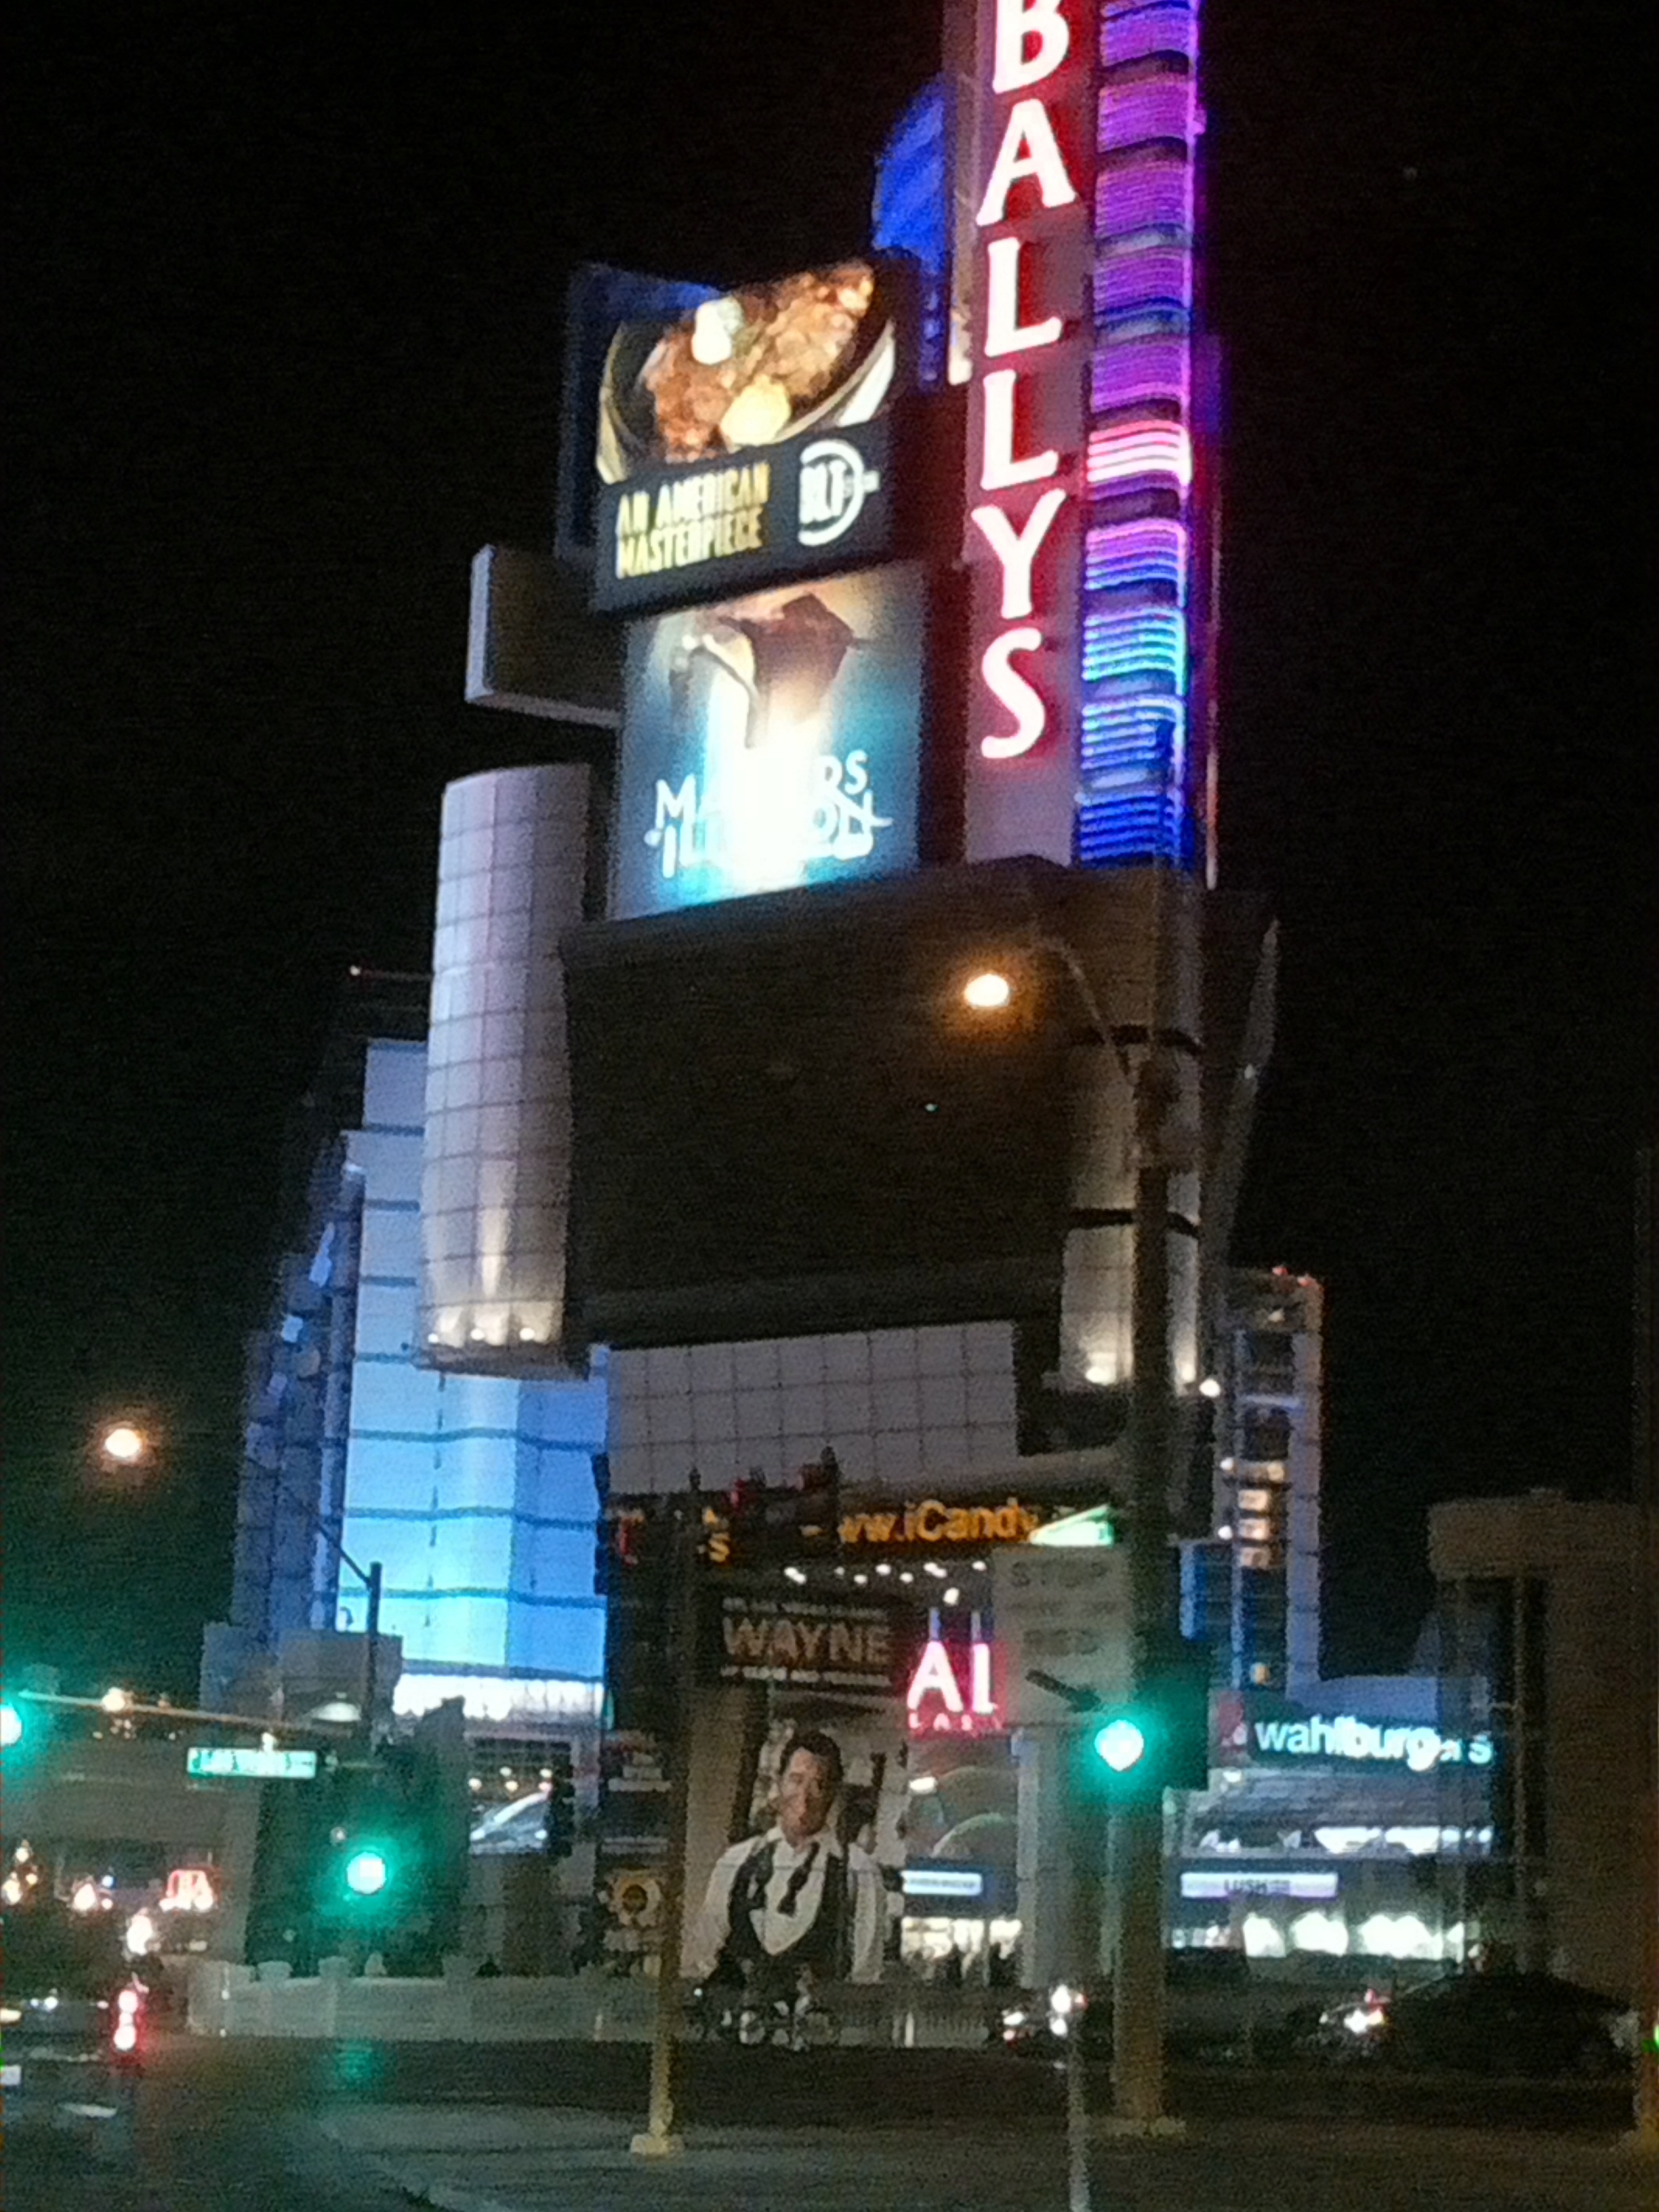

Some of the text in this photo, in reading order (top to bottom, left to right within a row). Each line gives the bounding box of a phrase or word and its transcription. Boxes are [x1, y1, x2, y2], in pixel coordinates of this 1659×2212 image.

[972, 0, 1076, 759] BALLYS
[617, 462, 770, 536] AN AMERICAN
[617, 506, 763, 578] MASTERPIECE
[722, 1617, 893, 1662] WAYNE
